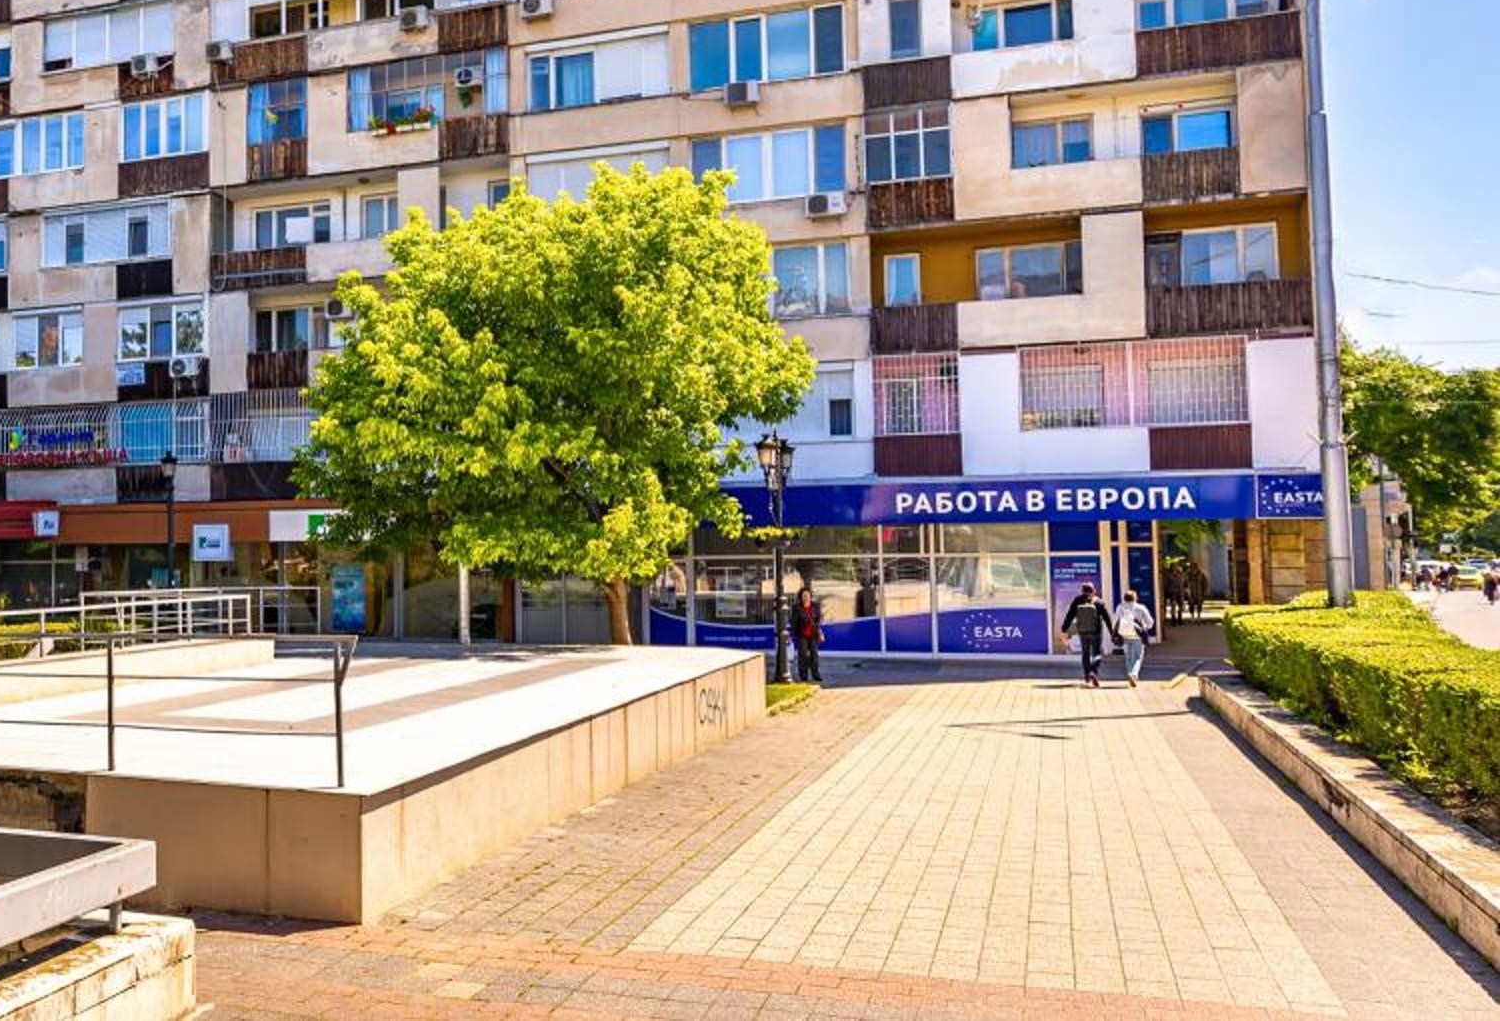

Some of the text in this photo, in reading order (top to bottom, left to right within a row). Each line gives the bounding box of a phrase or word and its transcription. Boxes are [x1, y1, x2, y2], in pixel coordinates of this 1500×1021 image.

[895, 486, 1197, 514] РАБОТА В ЕВРОПА
[1273, 491, 1324, 504] EASTA
[973, 626, 1023, 639] EASTA
